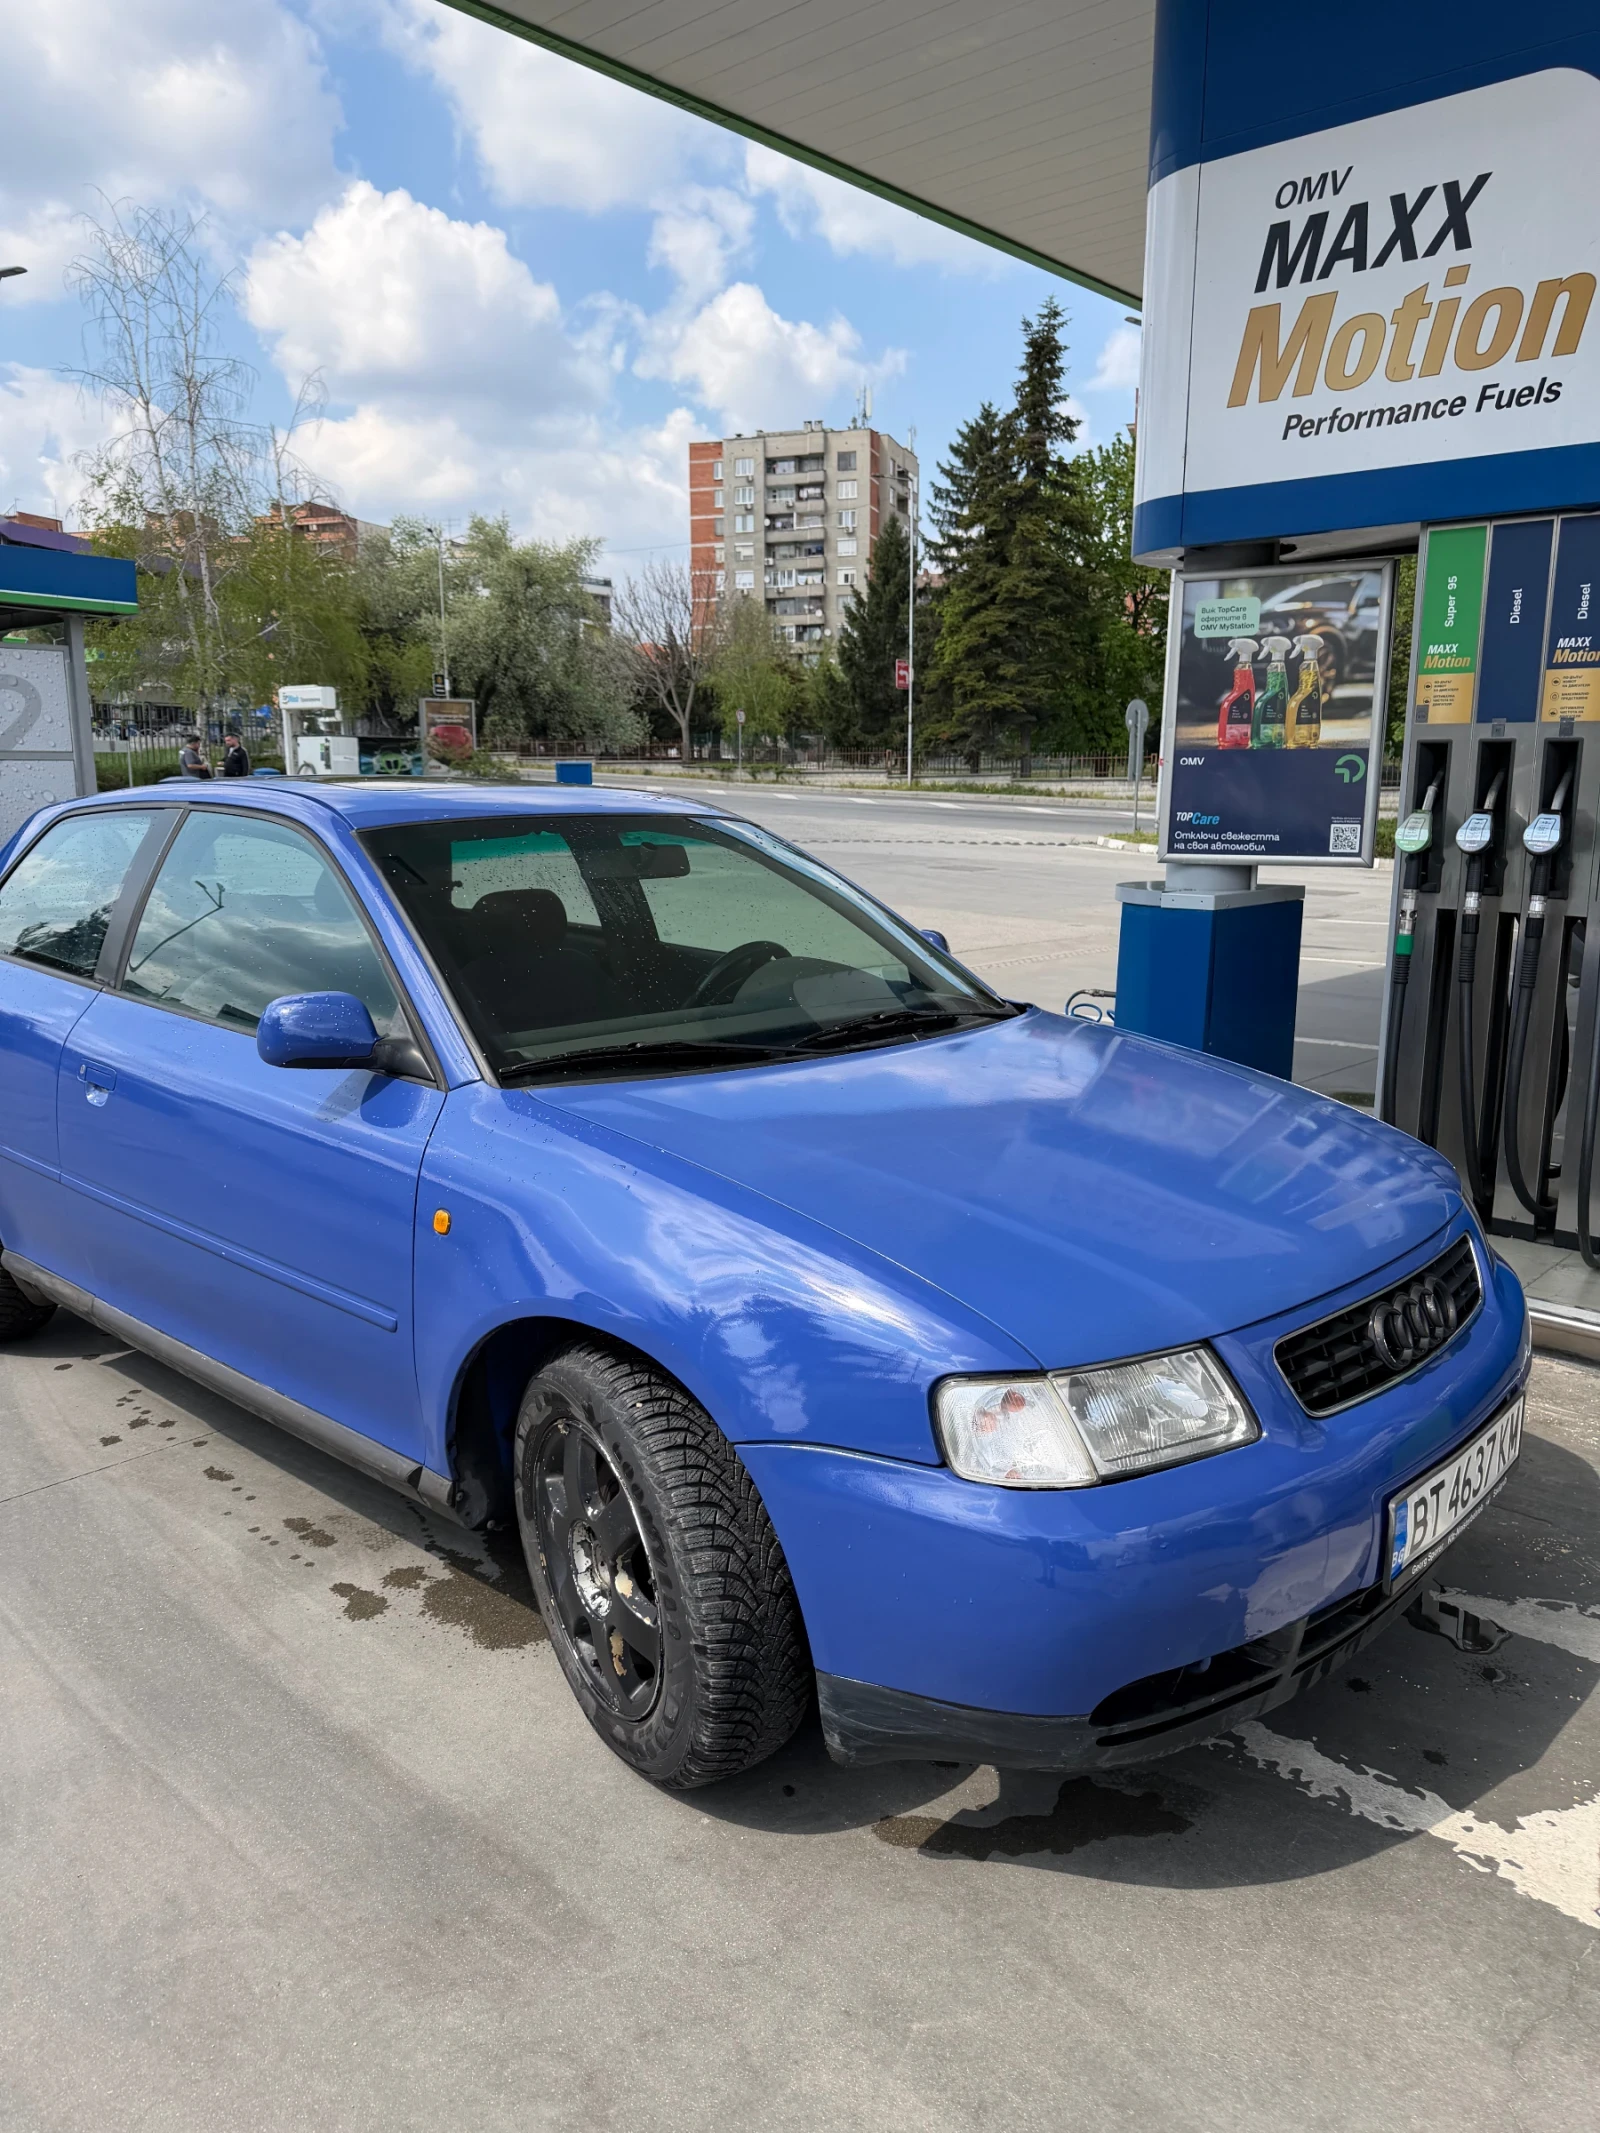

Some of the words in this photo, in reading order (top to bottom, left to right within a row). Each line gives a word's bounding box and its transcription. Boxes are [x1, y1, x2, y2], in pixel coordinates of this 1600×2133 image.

[1275, 166, 1353, 209] OMV
[1254, 171, 1493, 294] MAXX
[1226, 263, 1597, 409] Motion
[1282, 395, 1467, 440] Performance
[1475, 377, 1563, 412] Fuels
[1447, 575, 1458, 590] 95
[1217, 605, 1247, 614] TopCare
[1444, 594, 1457, 627] Super
[1509, 588, 1523, 624] Diesel
[1577, 583, 1591, 620] Diesel
[1219, 622, 1255, 631] MyStation
[1427, 643, 1459, 655] MAXX
[1556, 636, 1592, 648] MAXX
[1424, 654, 1471, 669] Motion
[1180, 757, 1205, 766] OMV
[1174, 831, 1219, 840] Отключи
[1220, 832, 1280, 842] свежестта
[1174, 842, 1185, 850] на
[1187, 841, 1209, 850] своя
[1210, 842, 1266, 852] автомобил
[1410, 1479, 1445, 1550] BT
[1447, 1431, 1497, 1518] 4637
[1497, 1405, 1521, 1474] KM
[1391, 1548, 1404, 1568] BG
[1411, 1557, 1428, 1575] Georg
